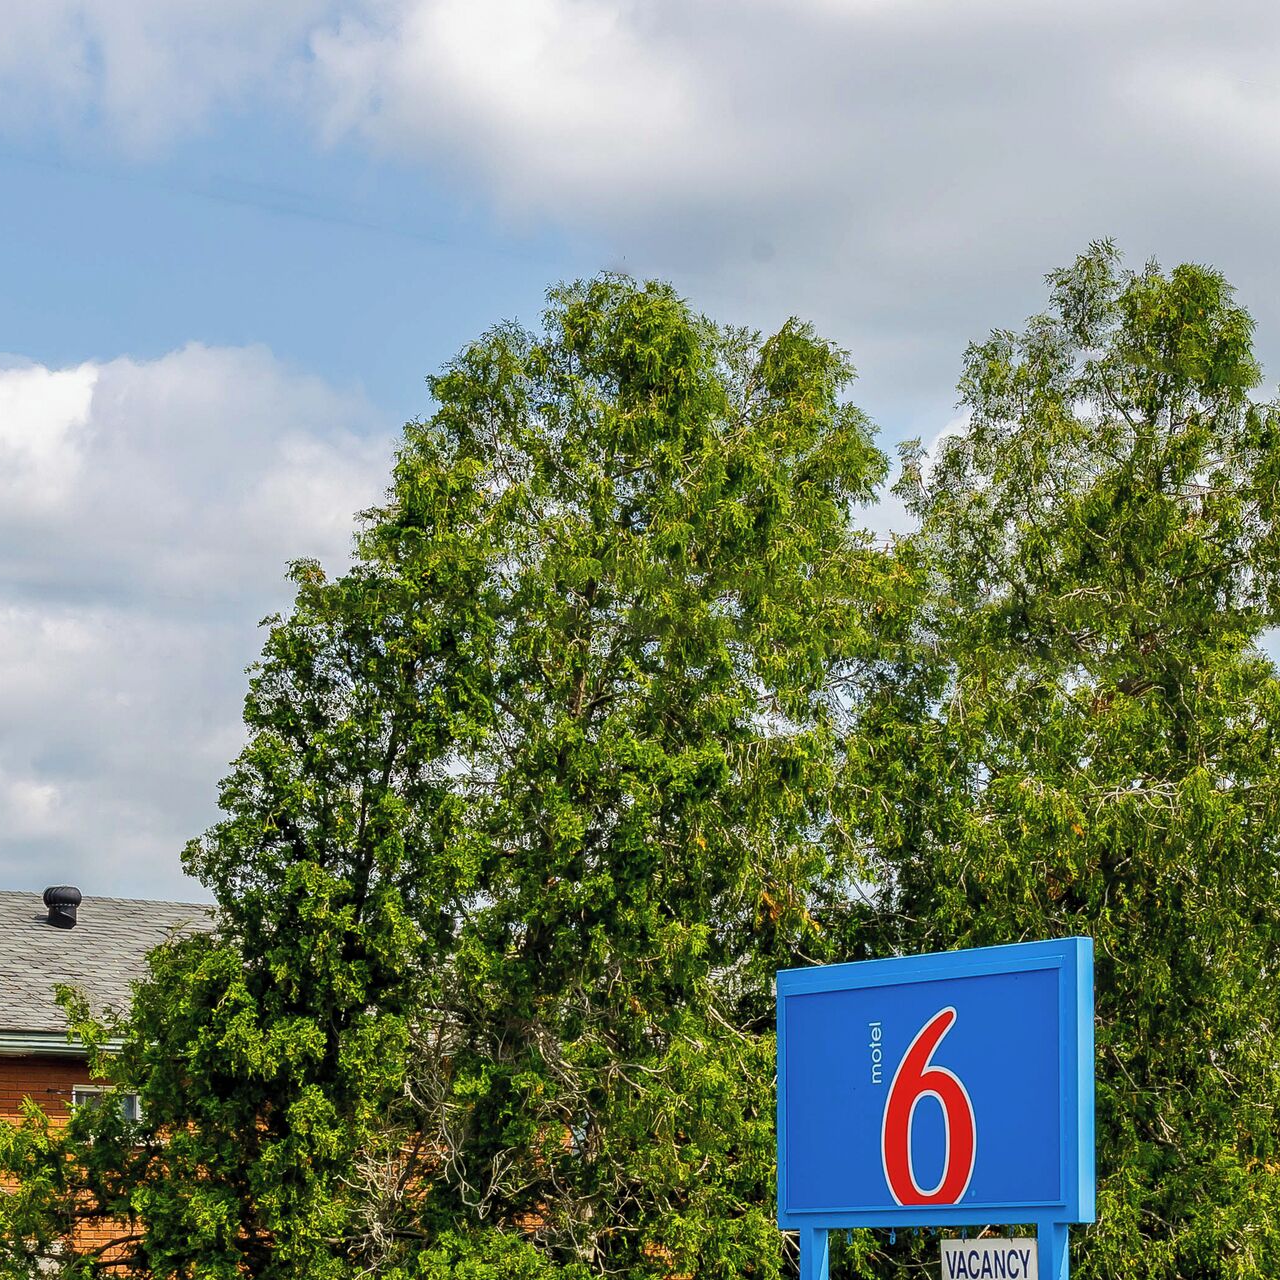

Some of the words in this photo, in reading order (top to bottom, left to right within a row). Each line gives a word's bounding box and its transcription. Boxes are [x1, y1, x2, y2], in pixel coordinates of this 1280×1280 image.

[868, 1021, 882, 1084] motel
[881, 1005, 978, 1207] 6
[945, 1249, 1031, 1280] VACANCY
